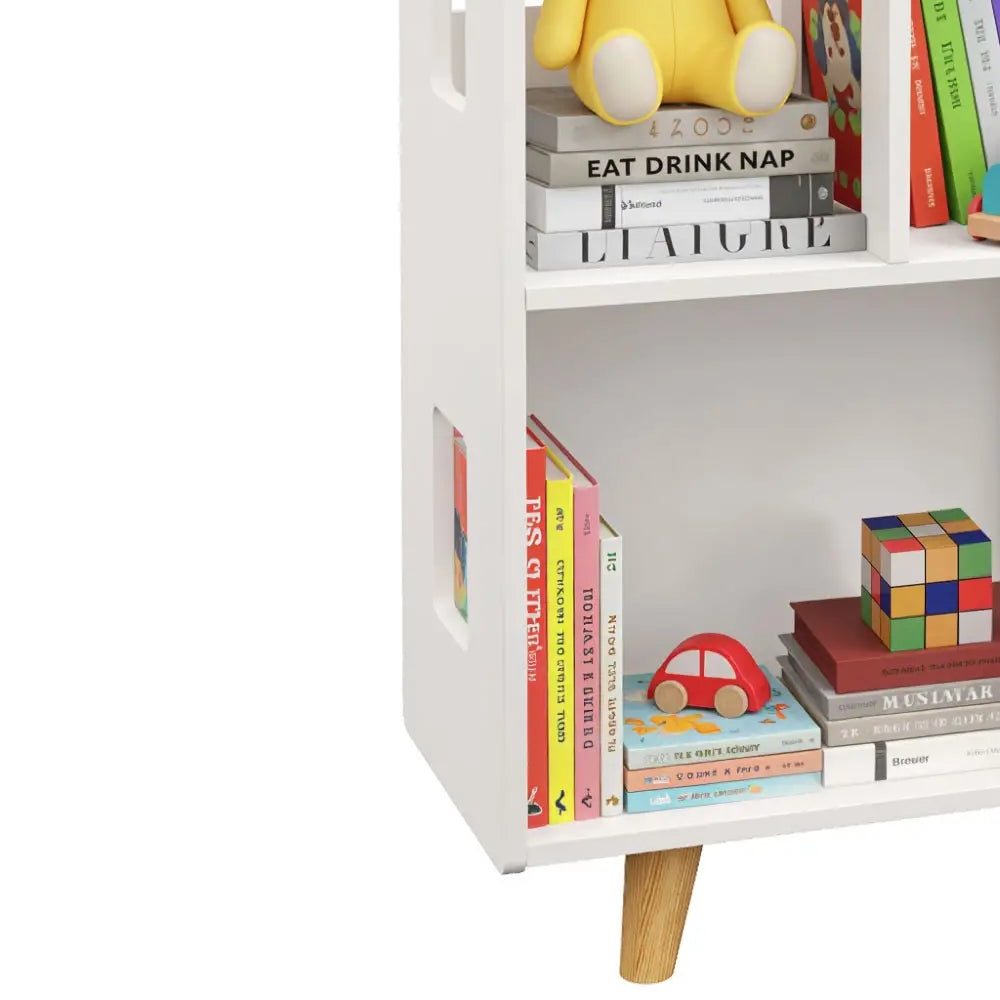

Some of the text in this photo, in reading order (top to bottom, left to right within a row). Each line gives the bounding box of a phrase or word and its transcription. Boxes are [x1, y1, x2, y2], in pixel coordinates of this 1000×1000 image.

[588, 150, 795, 178] EAT DRINK NAP
